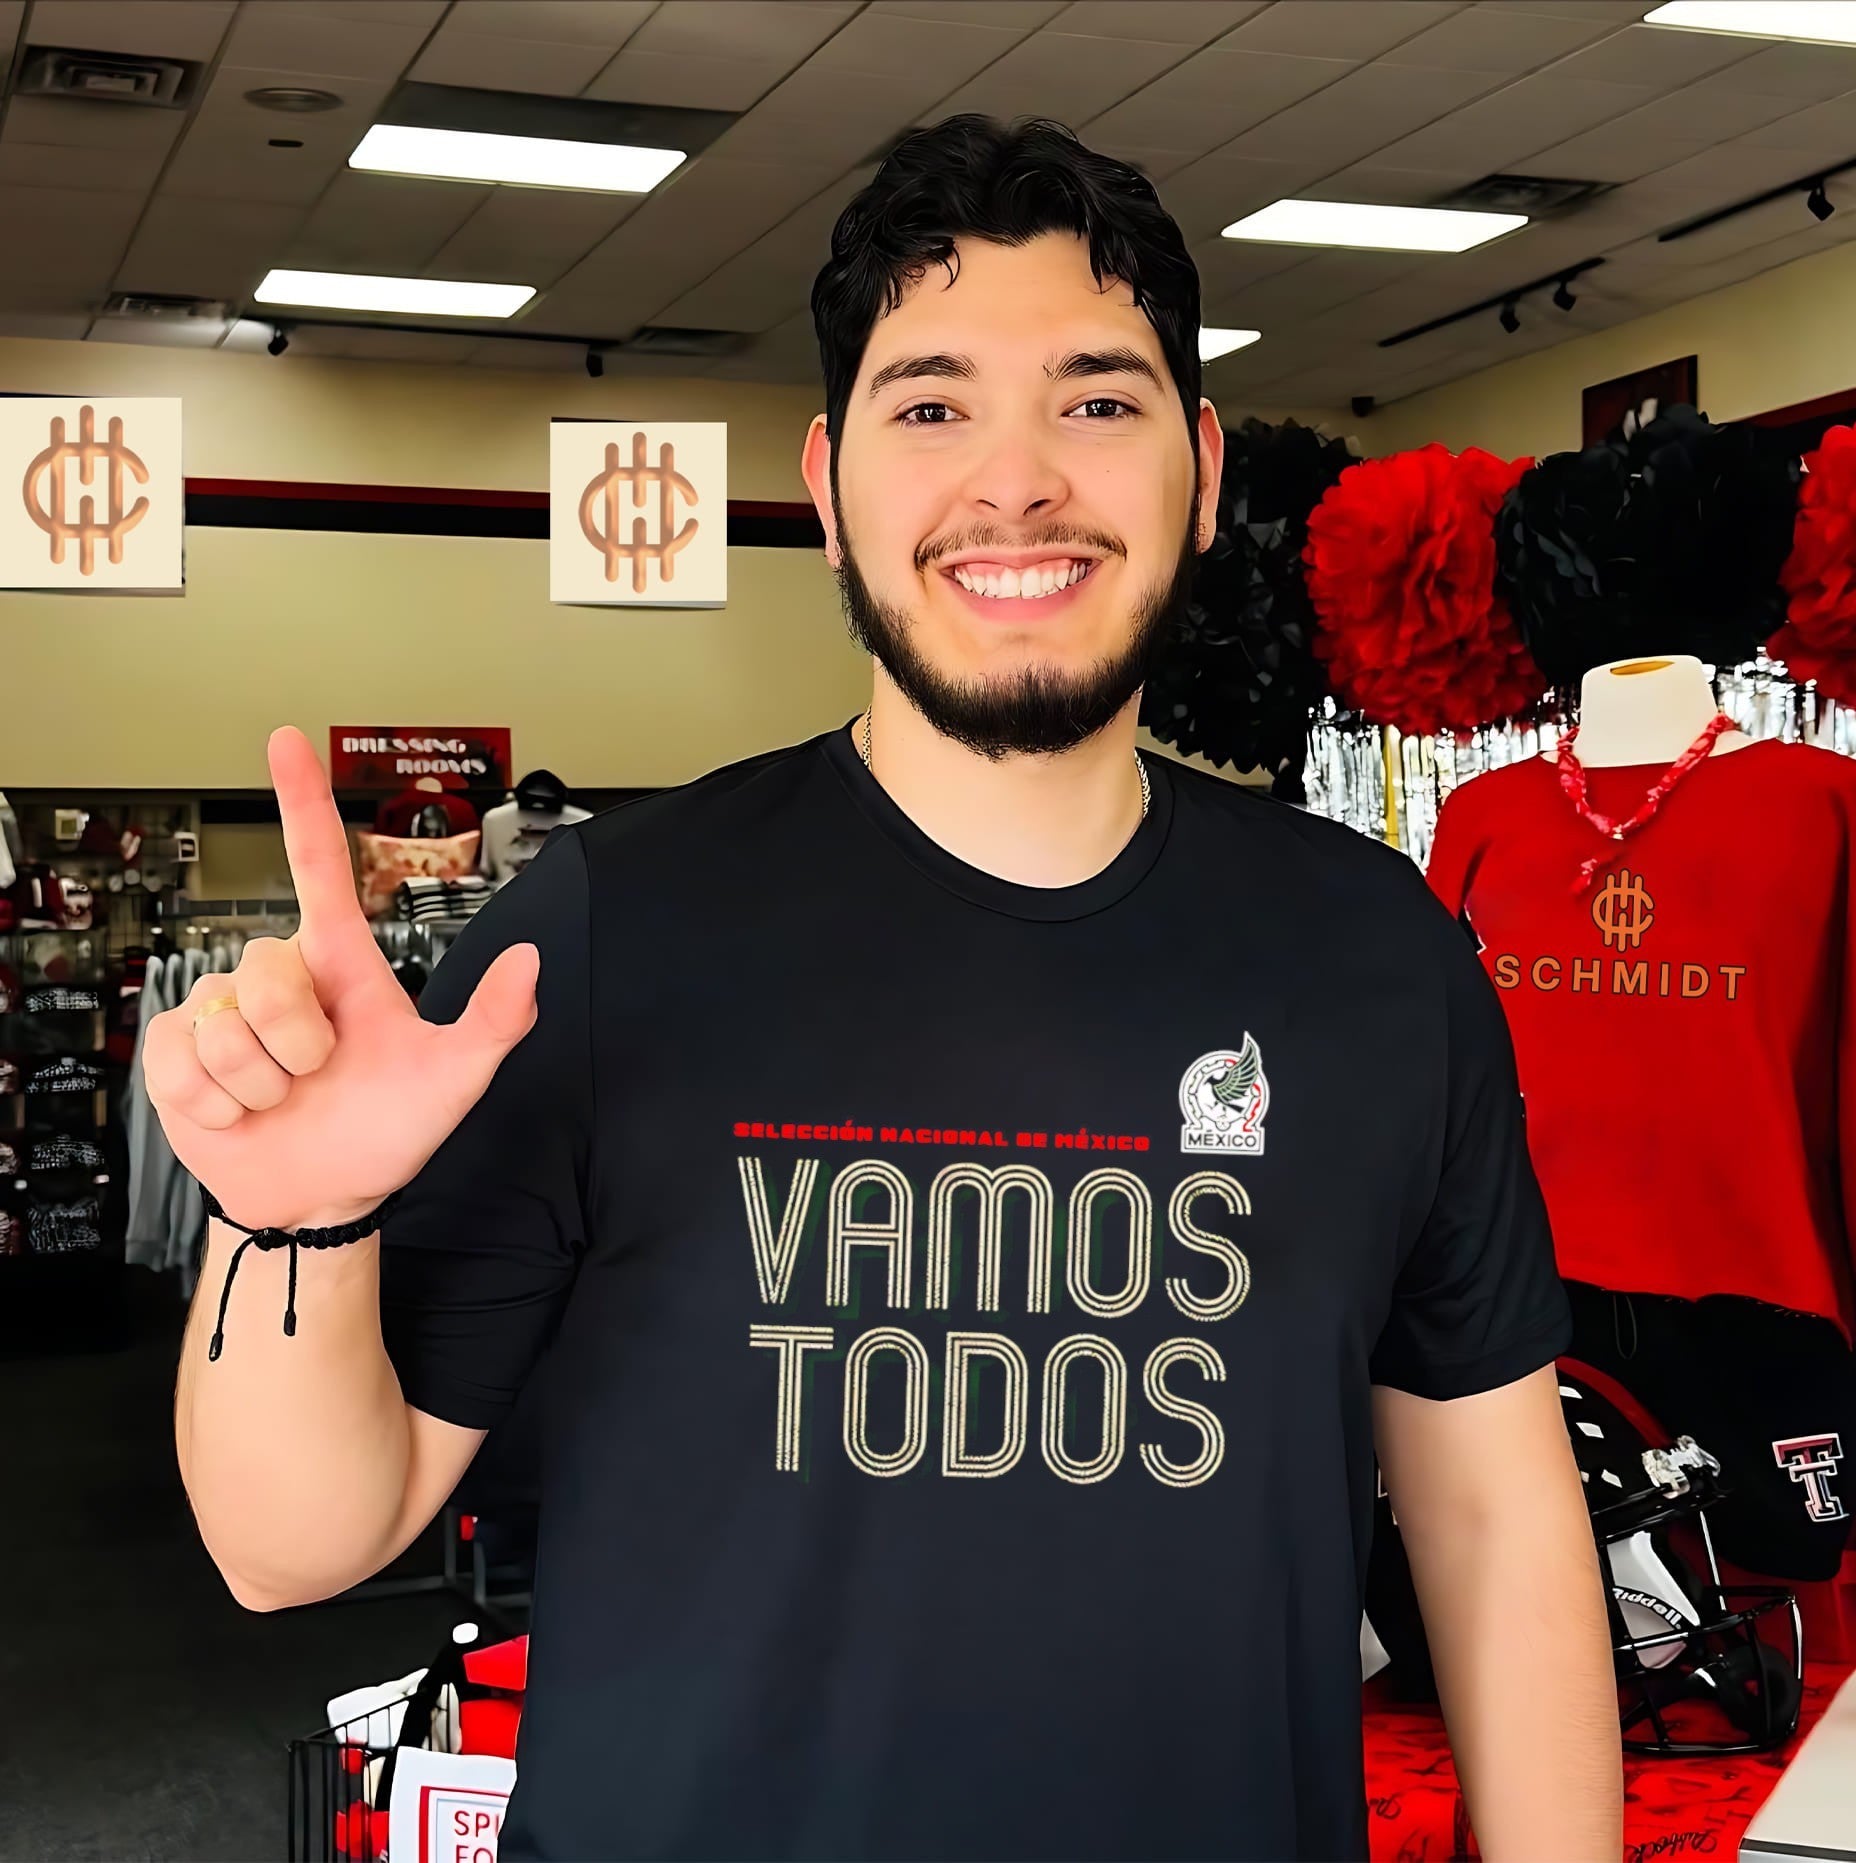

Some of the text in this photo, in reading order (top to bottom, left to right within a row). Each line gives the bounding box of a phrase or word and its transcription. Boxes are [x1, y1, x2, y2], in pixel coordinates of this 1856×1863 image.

[396, 759, 487, 774] ROOMS
[1494, 954, 1746, 1000] SCHMIDT
[733, 1119, 1150, 1151] SELECCIÓN NACIONAL DE MÉXICO
[1188, 1129, 1257, 1147] MÉXICO
[737, 1156, 1252, 1322] VAMOS
[749, 1324, 1227, 1488] TODOS
